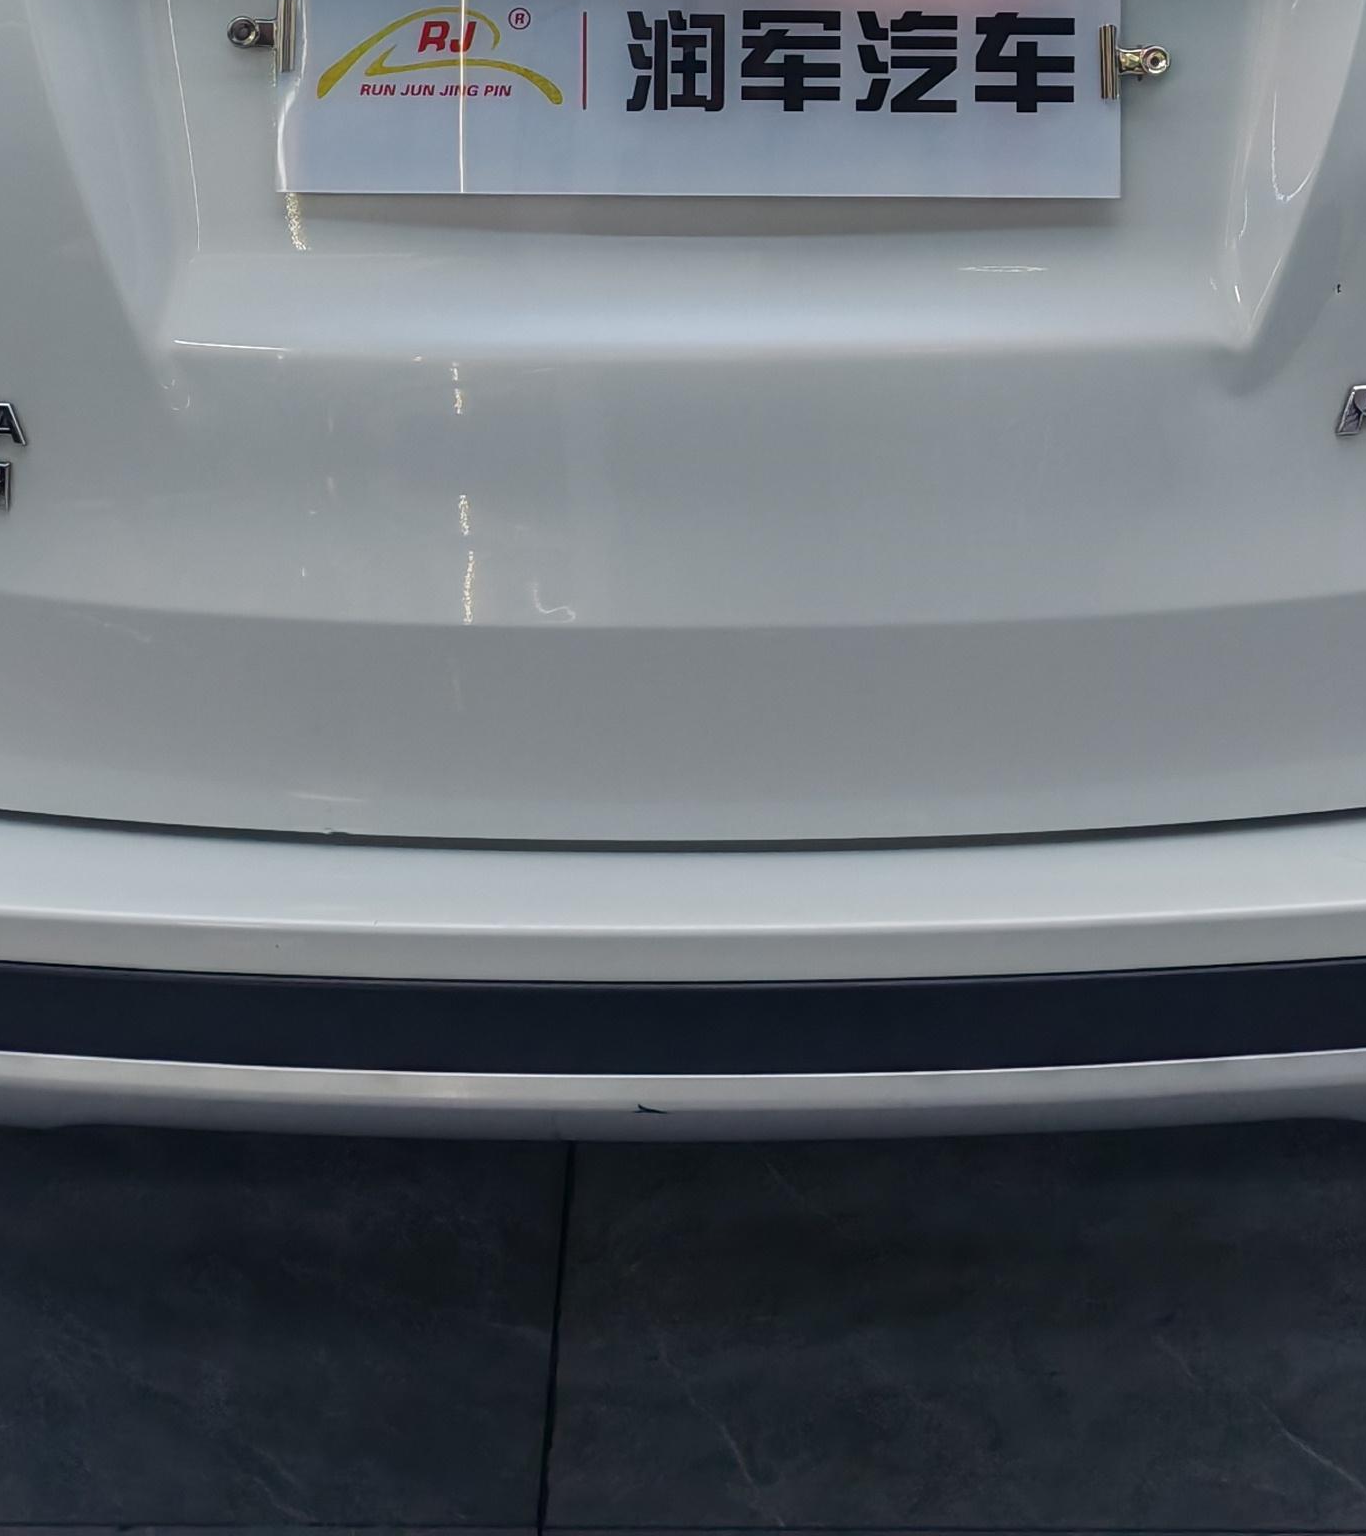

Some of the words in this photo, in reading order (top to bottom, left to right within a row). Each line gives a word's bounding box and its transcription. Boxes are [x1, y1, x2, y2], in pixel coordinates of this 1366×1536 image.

[418, 21, 477, 53] RJ
[626, 10, 1076, 113] 润军汽车
[360, 83, 396, 96] RUN
[400, 84, 435, 96] JUN
[439, 84, 479, 97] JING
[484, 85, 512, 97] PIN
